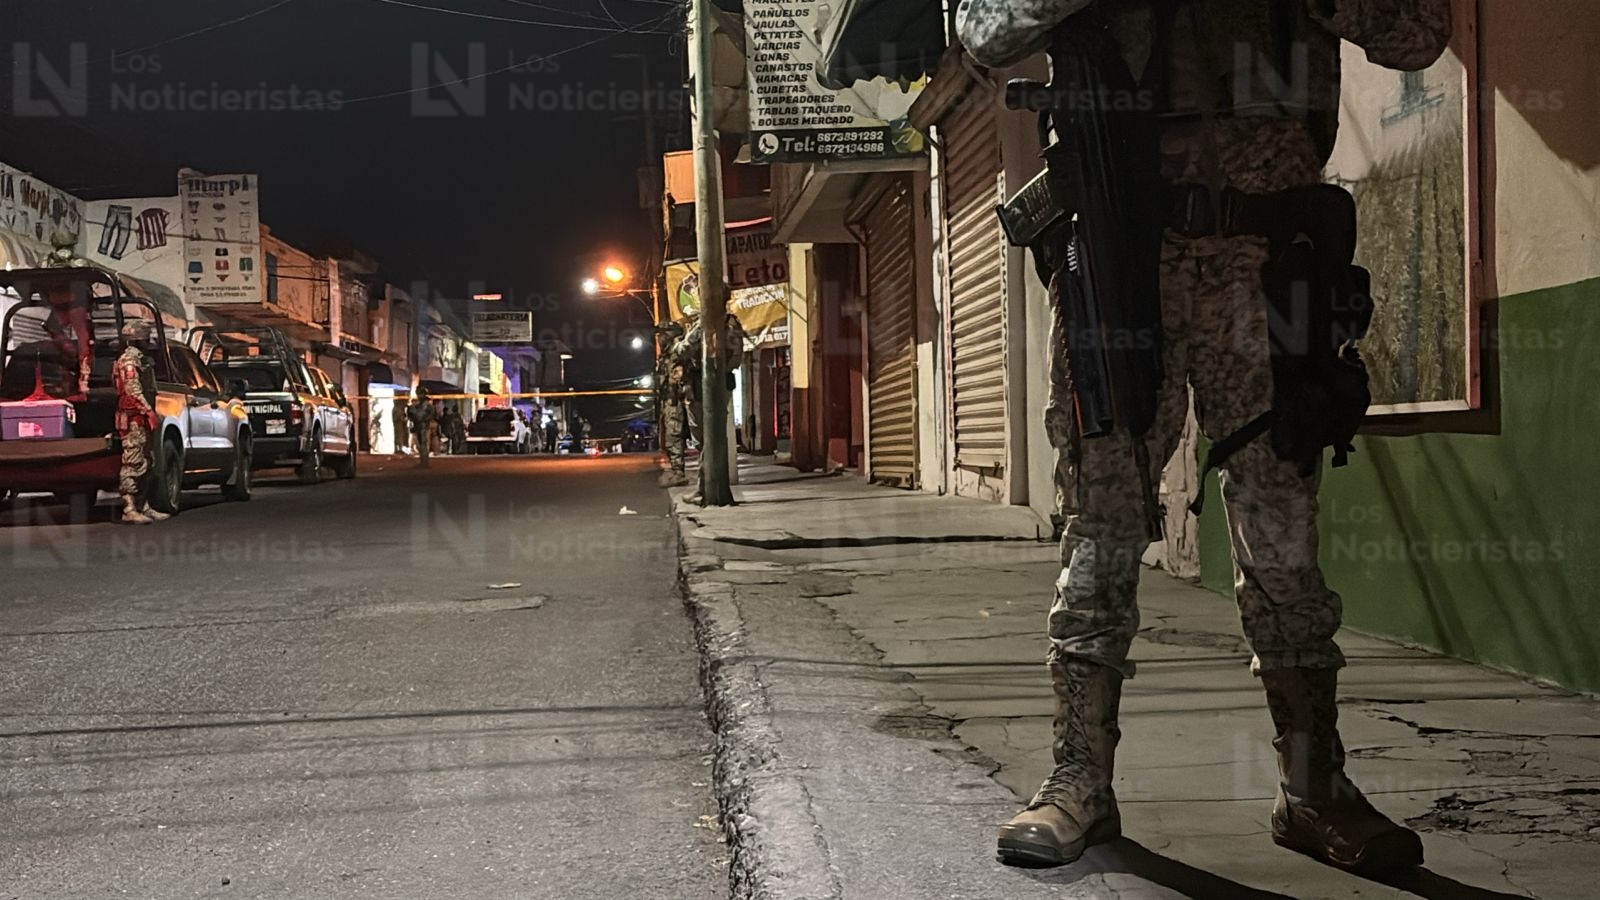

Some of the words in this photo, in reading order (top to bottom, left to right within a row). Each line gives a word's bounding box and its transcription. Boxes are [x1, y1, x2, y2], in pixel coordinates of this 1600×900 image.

[753, 7, 810, 18] PAÑUELOS
[752, 20, 795, 29] JAULAS
[754, 31, 803, 40] PETATES
[754, 42, 801, 51] JARCIAS
[754, 53, 790, 62] LONAS
[755, 63, 814, 73] CANASTOS
[756, 74, 808, 84] HAMACAS
[757, 85, 807, 95] CUBETAS
[757, 95, 836, 105] TRAPEADORES
[758, 106, 799, 116] TABLAS
[801, 105, 852, 115] TAQUERO
[758, 117, 799, 127] BOLSAS
[801, 116, 854, 126] MERCADO
[781, 136, 816, 153] Tel:
